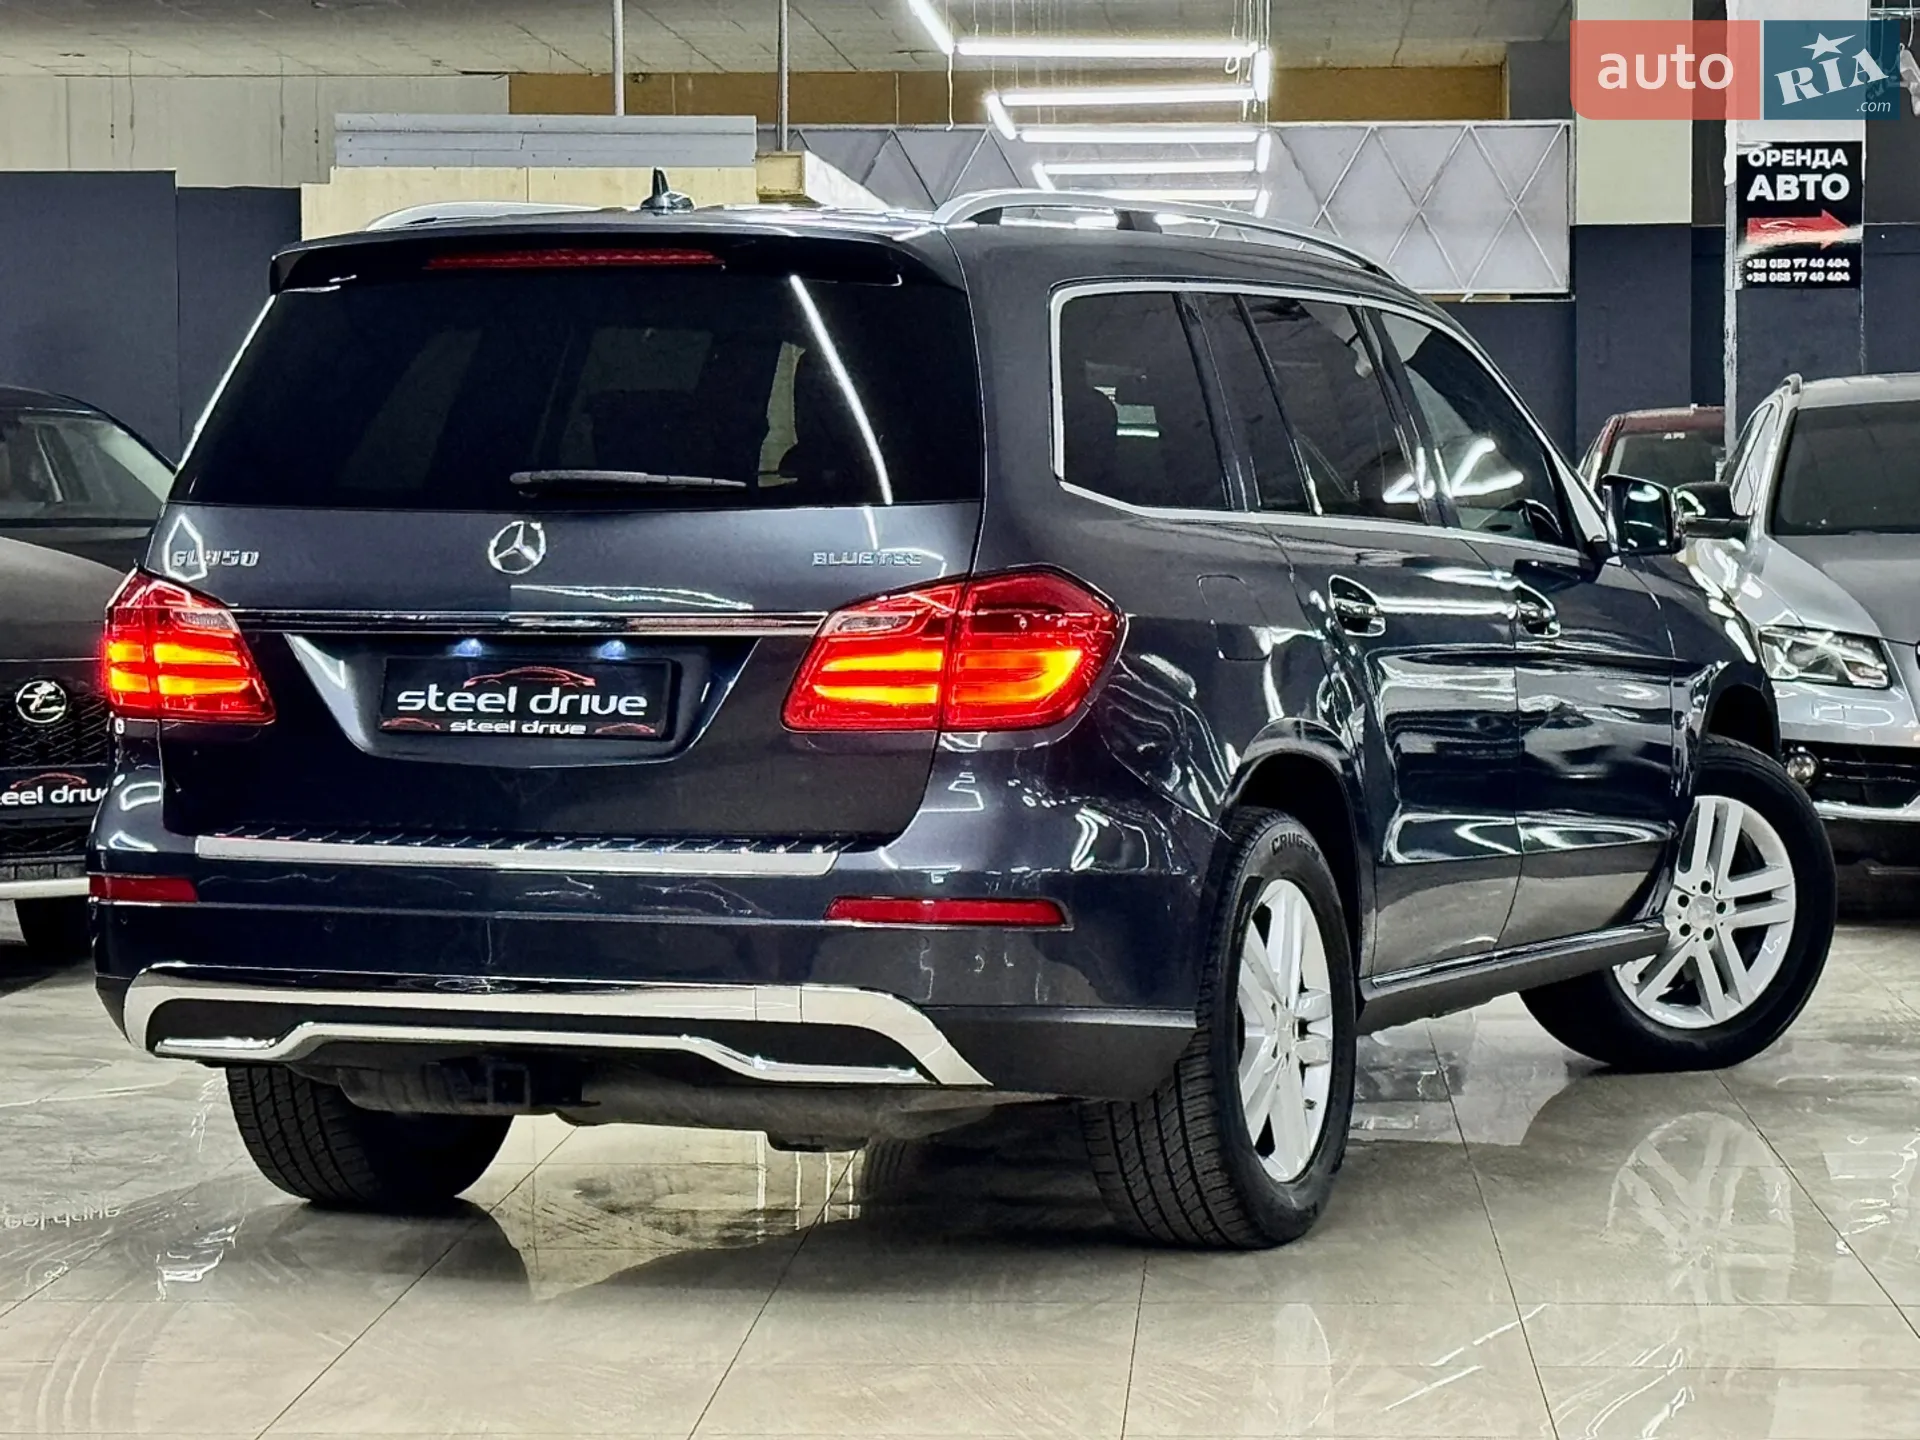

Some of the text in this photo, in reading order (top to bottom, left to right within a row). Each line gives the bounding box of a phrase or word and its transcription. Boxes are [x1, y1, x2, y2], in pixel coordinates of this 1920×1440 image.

[1747, 148, 1848, 169] ОРЕНДА
[1746, 173, 1850, 201] АВТО
[1793, 257, 1807, 268] 77
[1809, 257, 1825, 268] 40
[1826, 257, 1850, 268] 404
[1793, 271, 1807, 282] 77
[1809, 271, 1825, 281] 40
[1826, 271, 1850, 281] 404
[397, 684, 648, 716] steel drive
[449, 719, 587, 735] steel drive
[0, 785, 43, 805] eel
